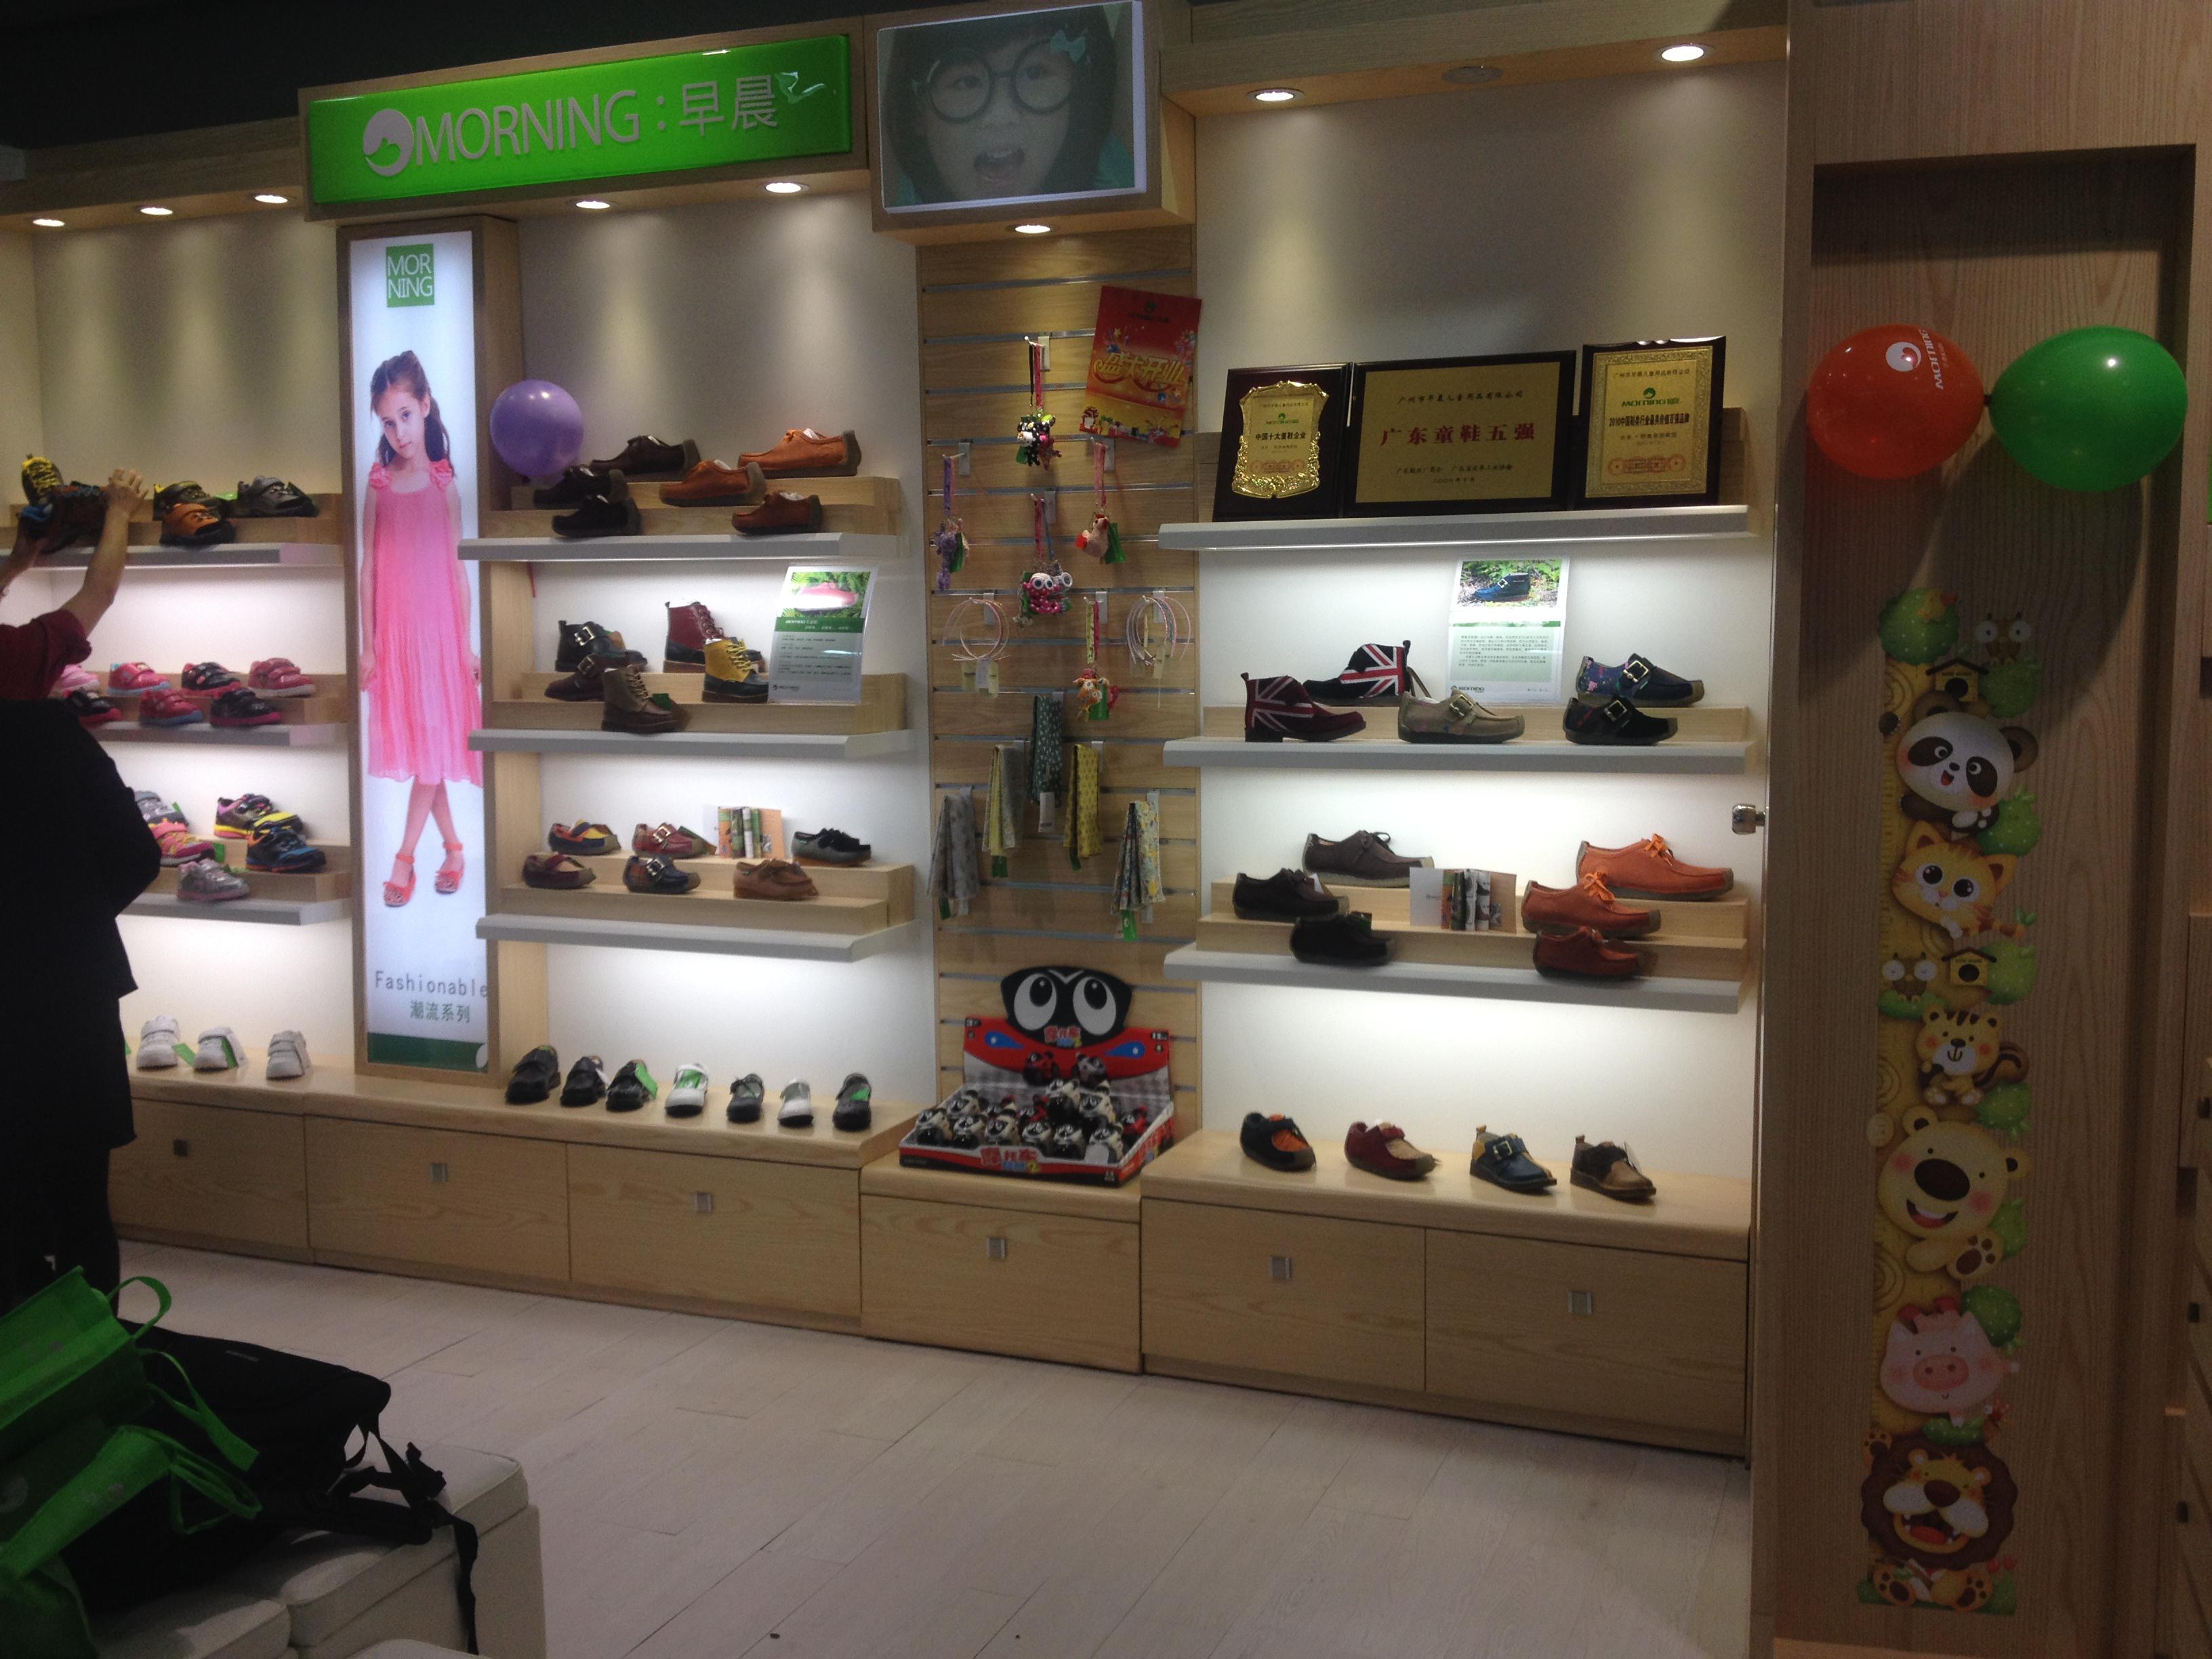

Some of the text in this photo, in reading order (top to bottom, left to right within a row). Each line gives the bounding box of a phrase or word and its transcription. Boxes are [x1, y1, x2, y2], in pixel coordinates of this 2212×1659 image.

[415, 89, 640, 167] MORNING
[678, 75, 779, 137] 早晨
[387, 253, 432, 277] MOR
[388, 276, 434, 299] NING
[1093, 352, 1185, 387] 盛大开业
[1380, 422, 1535, 446] 广东童鞋五强
[375, 969, 488, 998] Fashionable
[410, 1000, 471, 1024] 潮流系列
